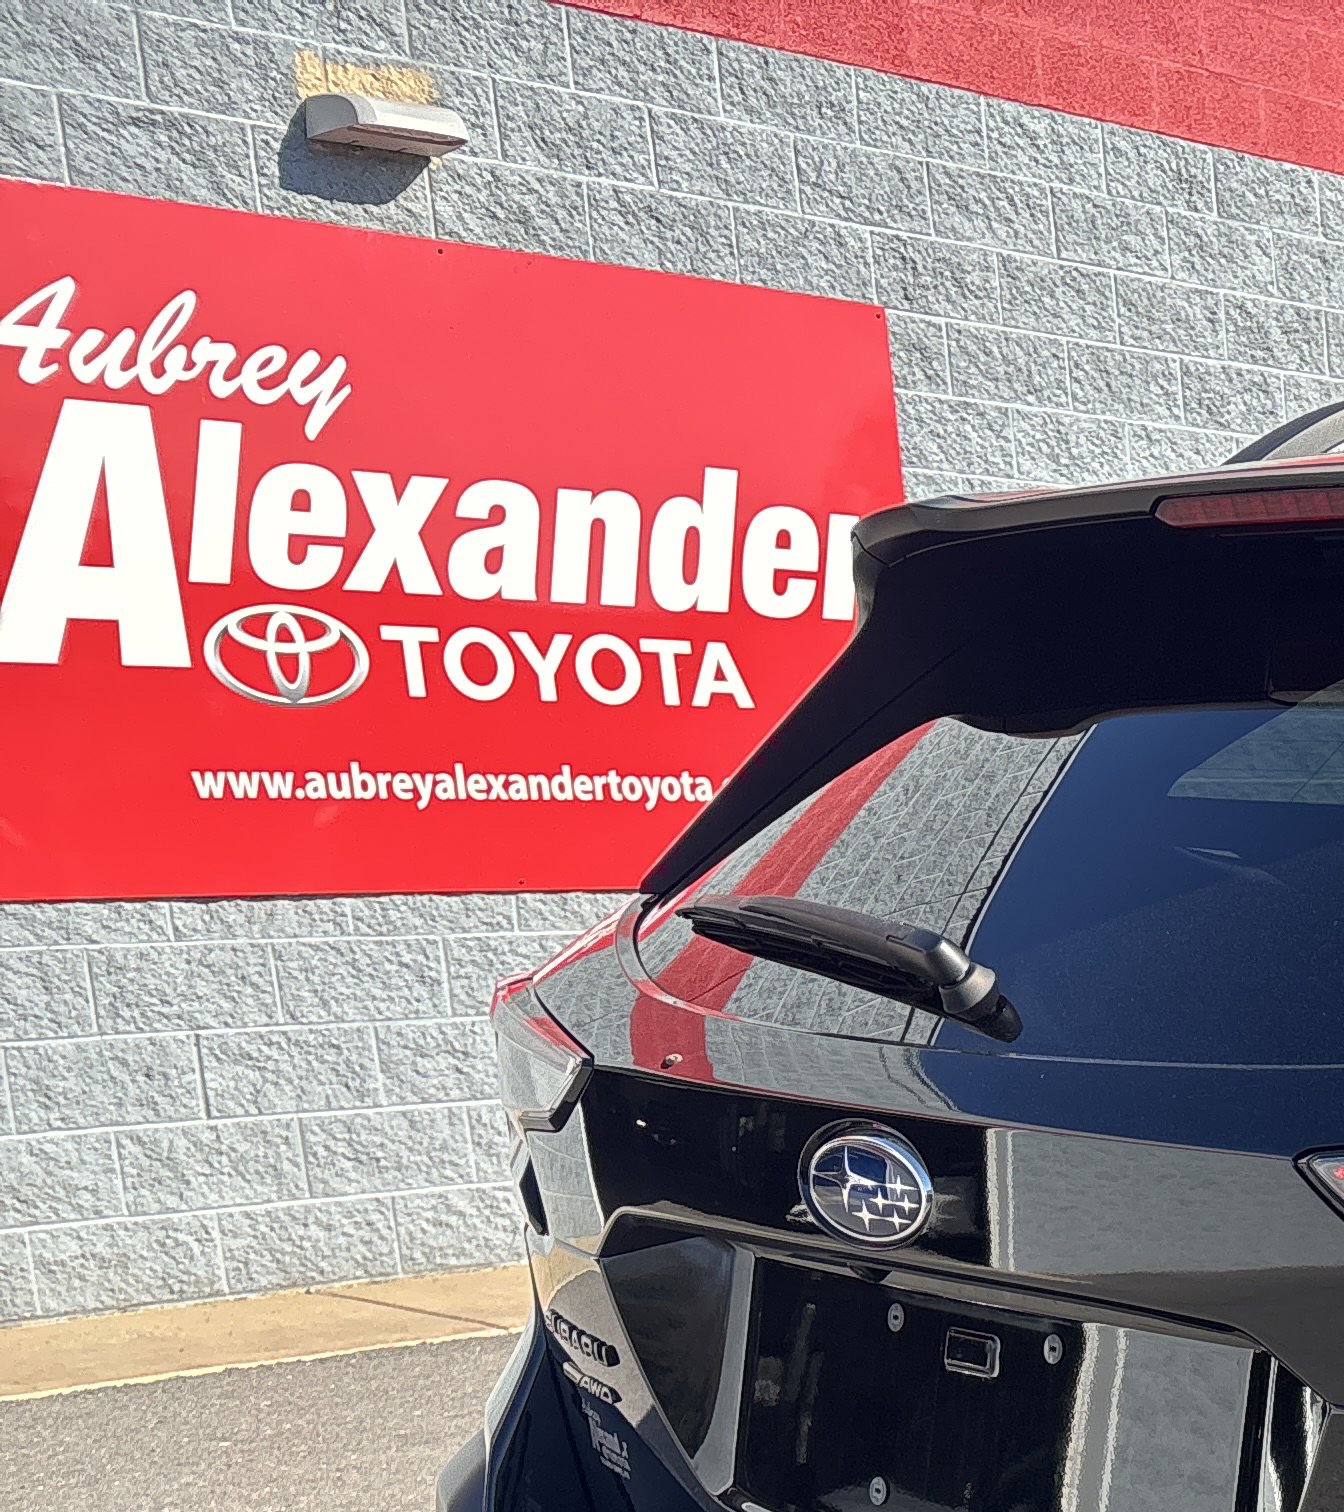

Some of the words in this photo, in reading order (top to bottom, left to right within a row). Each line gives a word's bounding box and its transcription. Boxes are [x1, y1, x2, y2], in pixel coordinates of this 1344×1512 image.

[0, 275, 352, 441] Aubrey
[379, 624, 756, 710] TOYOTA
[191, 761, 731, 811] www.aubreyalexandertoyota
